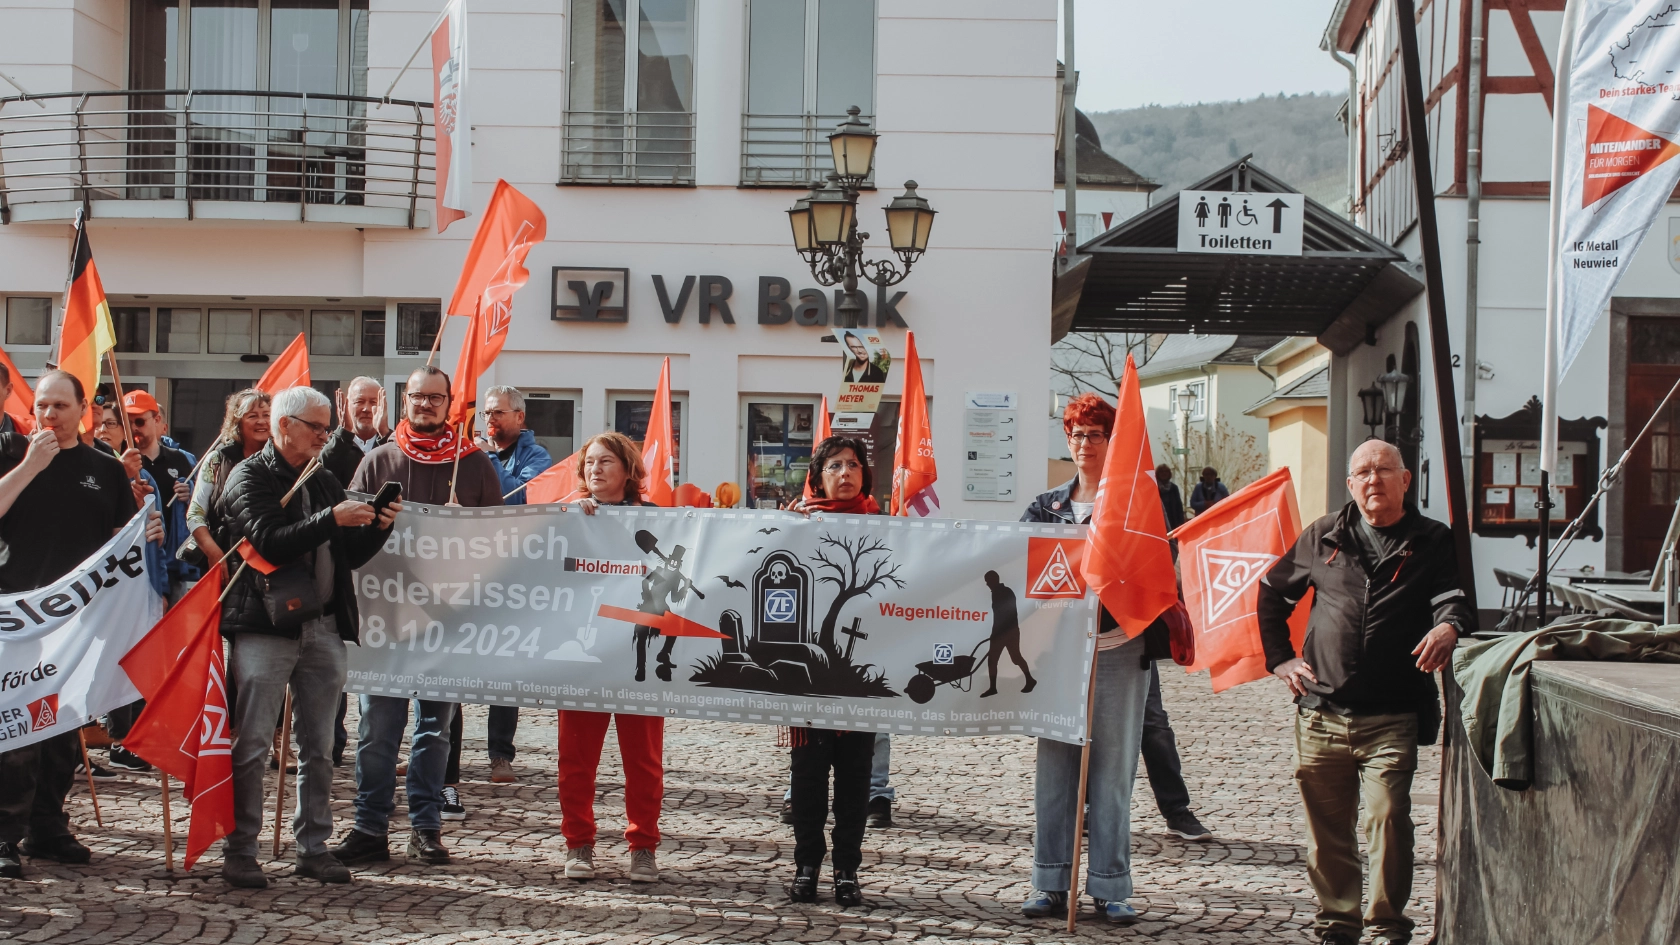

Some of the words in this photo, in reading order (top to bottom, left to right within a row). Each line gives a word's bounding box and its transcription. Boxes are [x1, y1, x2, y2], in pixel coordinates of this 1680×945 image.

[1600, 87, 1620, 99] Dein
[1621, 84, 1656, 97] starkes
[1590, 138, 1661, 154] MITEINANDER
[1589, 157, 1605, 169] FÜR
[1605, 155, 1640, 168] MORGEN
[1198, 234, 1272, 250] Toiletten
[1573, 241, 1584, 252] IG
[1585, 239, 1618, 252] Metall
[1573, 256, 1618, 269] Neuwied
[651, 274, 736, 325] VR
[757, 274, 909, 329] Bank
[848, 384, 880, 393] THOMAS
[838, 394, 864, 403] MEYER
[383, 525, 569, 561] atenstich
[575, 558, 647, 575] Holdmann
[351, 571, 575, 612] iederzissen
[879, 602, 988, 622] Wagenleitner
[1035, 600, 1074, 609] Neuwied
[2, 661, 58, 692] förde
[347, 669, 387, 682] onaten
[390, 674, 414, 684] vom
[416, 673, 484, 689] Spatenstich
[487, 680, 512, 691] zum
[516, 680, 590, 697] Totengräber
[601, 687, 613, 699] In
[617, 687, 658, 702] dieses
[663, 691, 745, 708] Management
[749, 696, 789, 711] haben
[792, 700, 812, 713] wir
[816, 701, 844, 715] kein
[848, 704, 917, 721] Vertrauen,
[921, 708, 946, 721] das
[950, 709, 1015, 722] brauchen
[1018, 708, 1040, 721] wir
[1042, 711, 1076, 728] nicht!
[0, 708, 24, 724] ER
